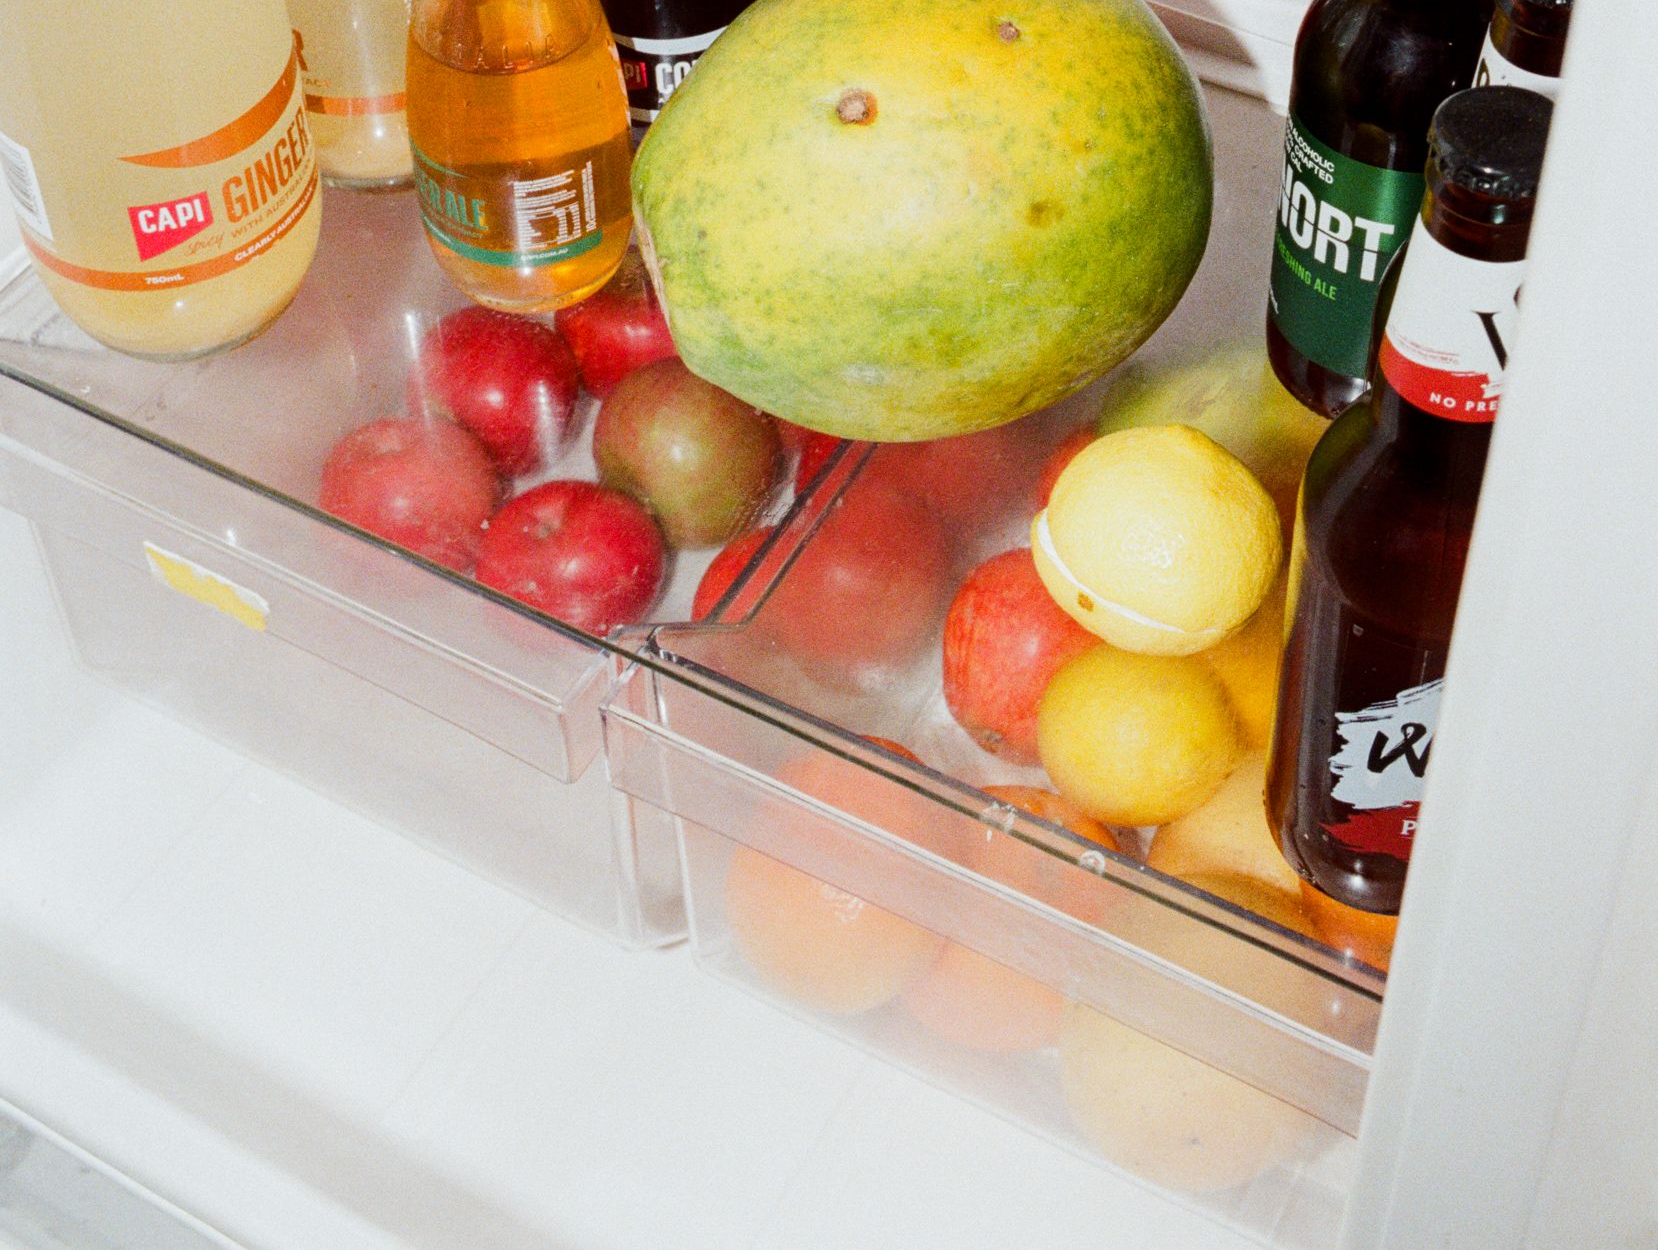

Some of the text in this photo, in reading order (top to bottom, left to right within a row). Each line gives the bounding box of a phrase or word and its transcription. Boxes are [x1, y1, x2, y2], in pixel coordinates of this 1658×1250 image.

[655, 59, 697, 94] CO
[138, 198, 205, 234] CAPI
[145, 272, 185, 285] 750mL
[1313, 275, 1337, 300] ALE
[1430, 392, 1457, 409] NO
